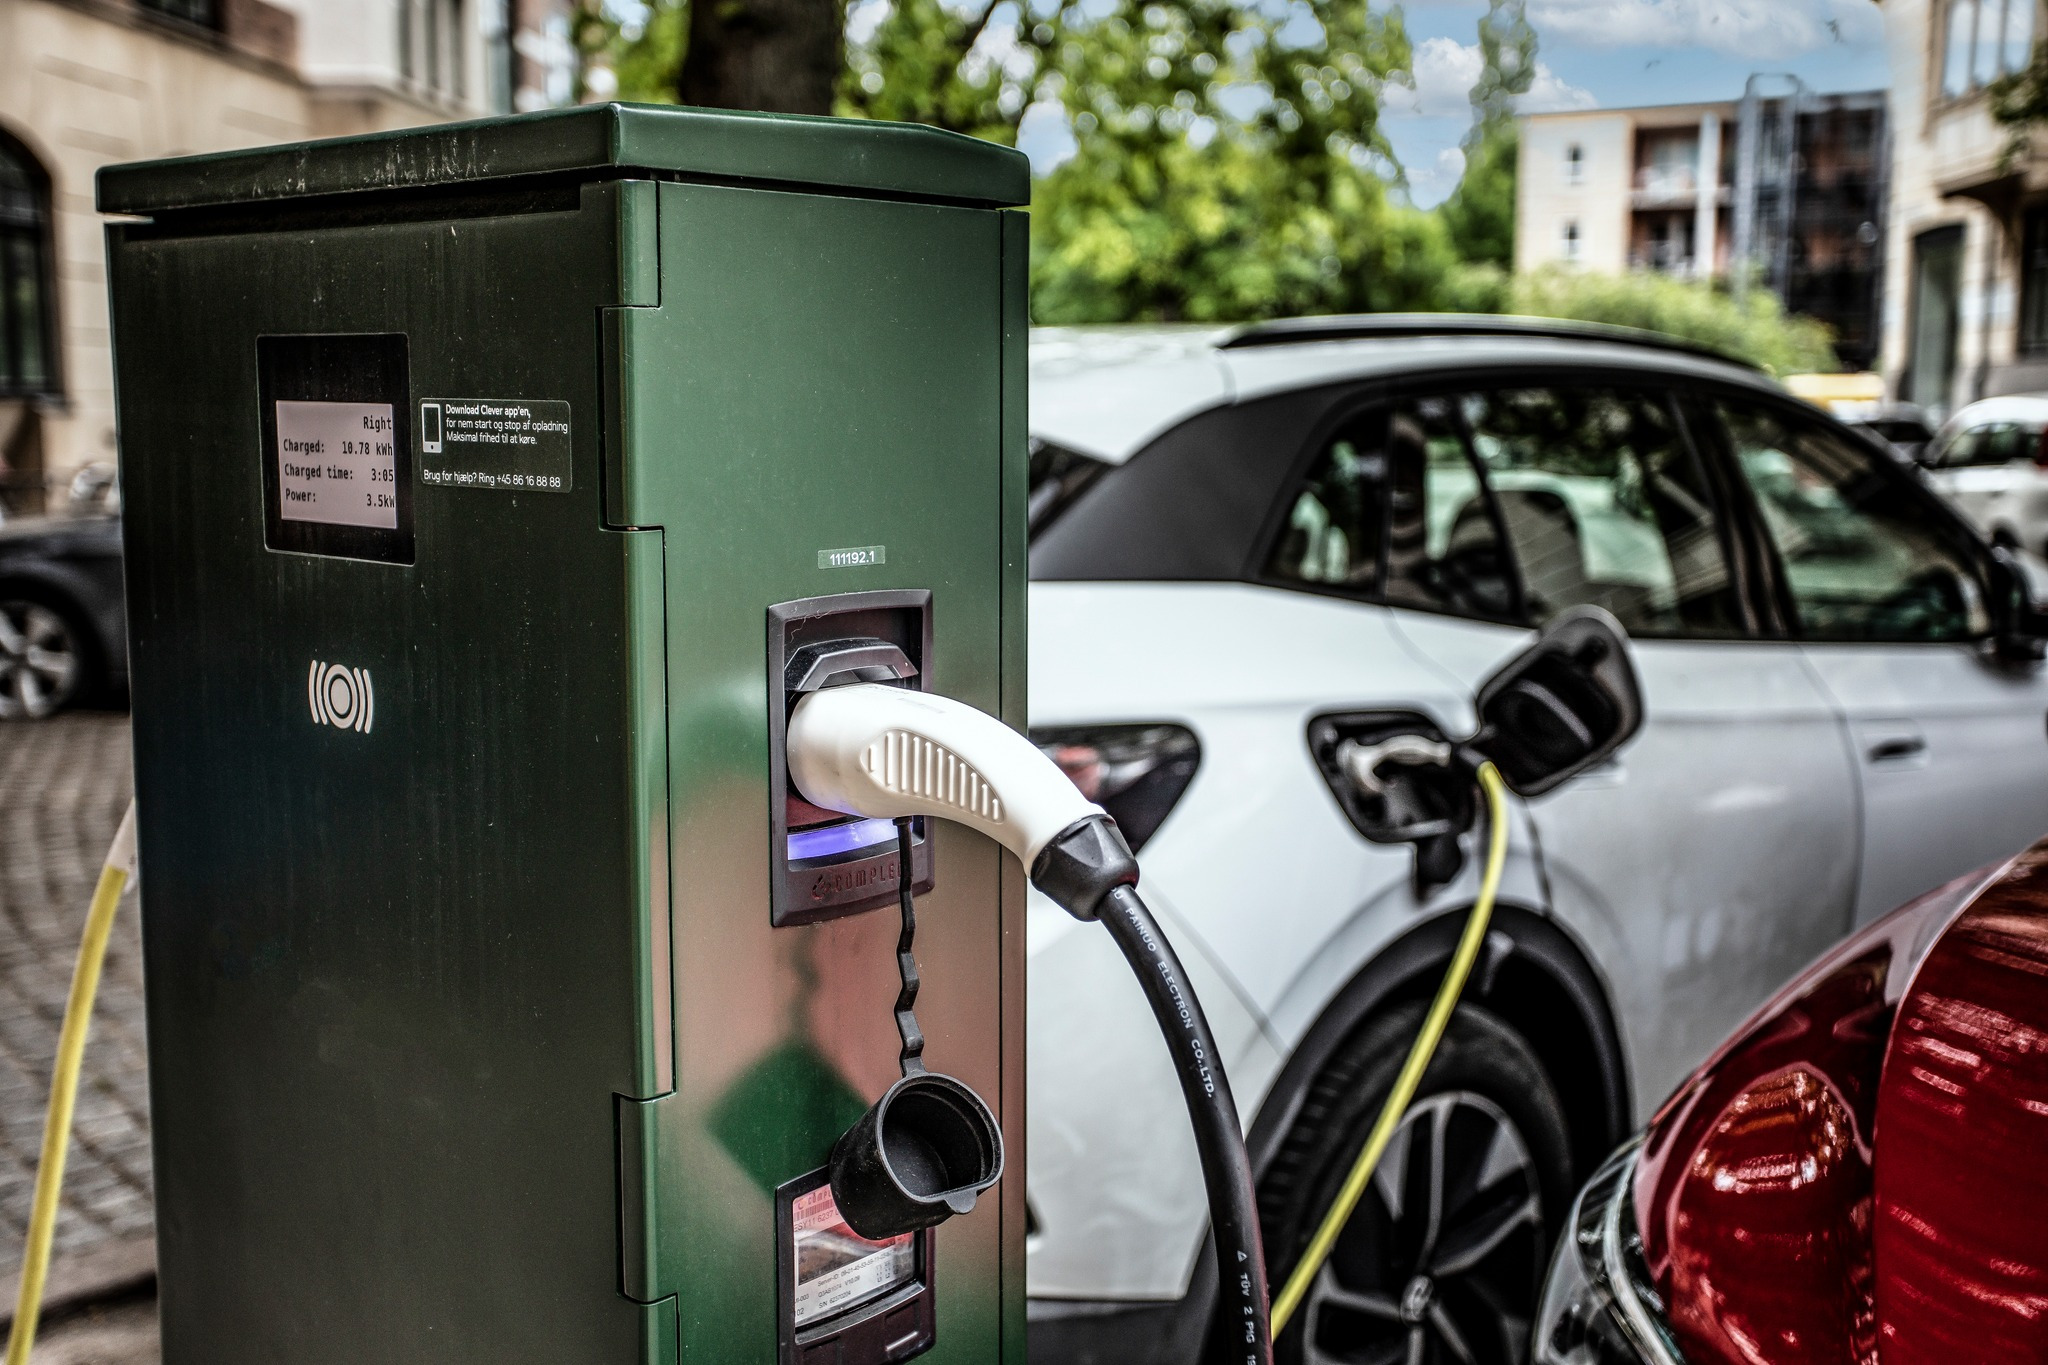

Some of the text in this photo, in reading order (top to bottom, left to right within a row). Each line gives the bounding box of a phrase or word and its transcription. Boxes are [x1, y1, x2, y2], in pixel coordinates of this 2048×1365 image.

[445, 404, 531, 418] Download Clever app'en,
[363, 415, 392, 432] Right
[446, 418, 568, 434] for nem start og stop af opladning
[446, 432, 537, 445] Maksimal frihed til at køre.
[283, 439, 393, 456] Charged: 10.78 kWh
[284, 463, 394, 482] Charged time: 3:05
[424, 469, 561, 488] Brug for hjælp? Ring +45 86 16 88 88
[286, 488, 316, 502] Power:
[830, 550, 876, 566] 111192.1
[1125, 908, 1157, 952] PAINUO
[1157, 962, 1194, 1029] ELECTRON
[1244, 1306, 1253, 1315] 2
